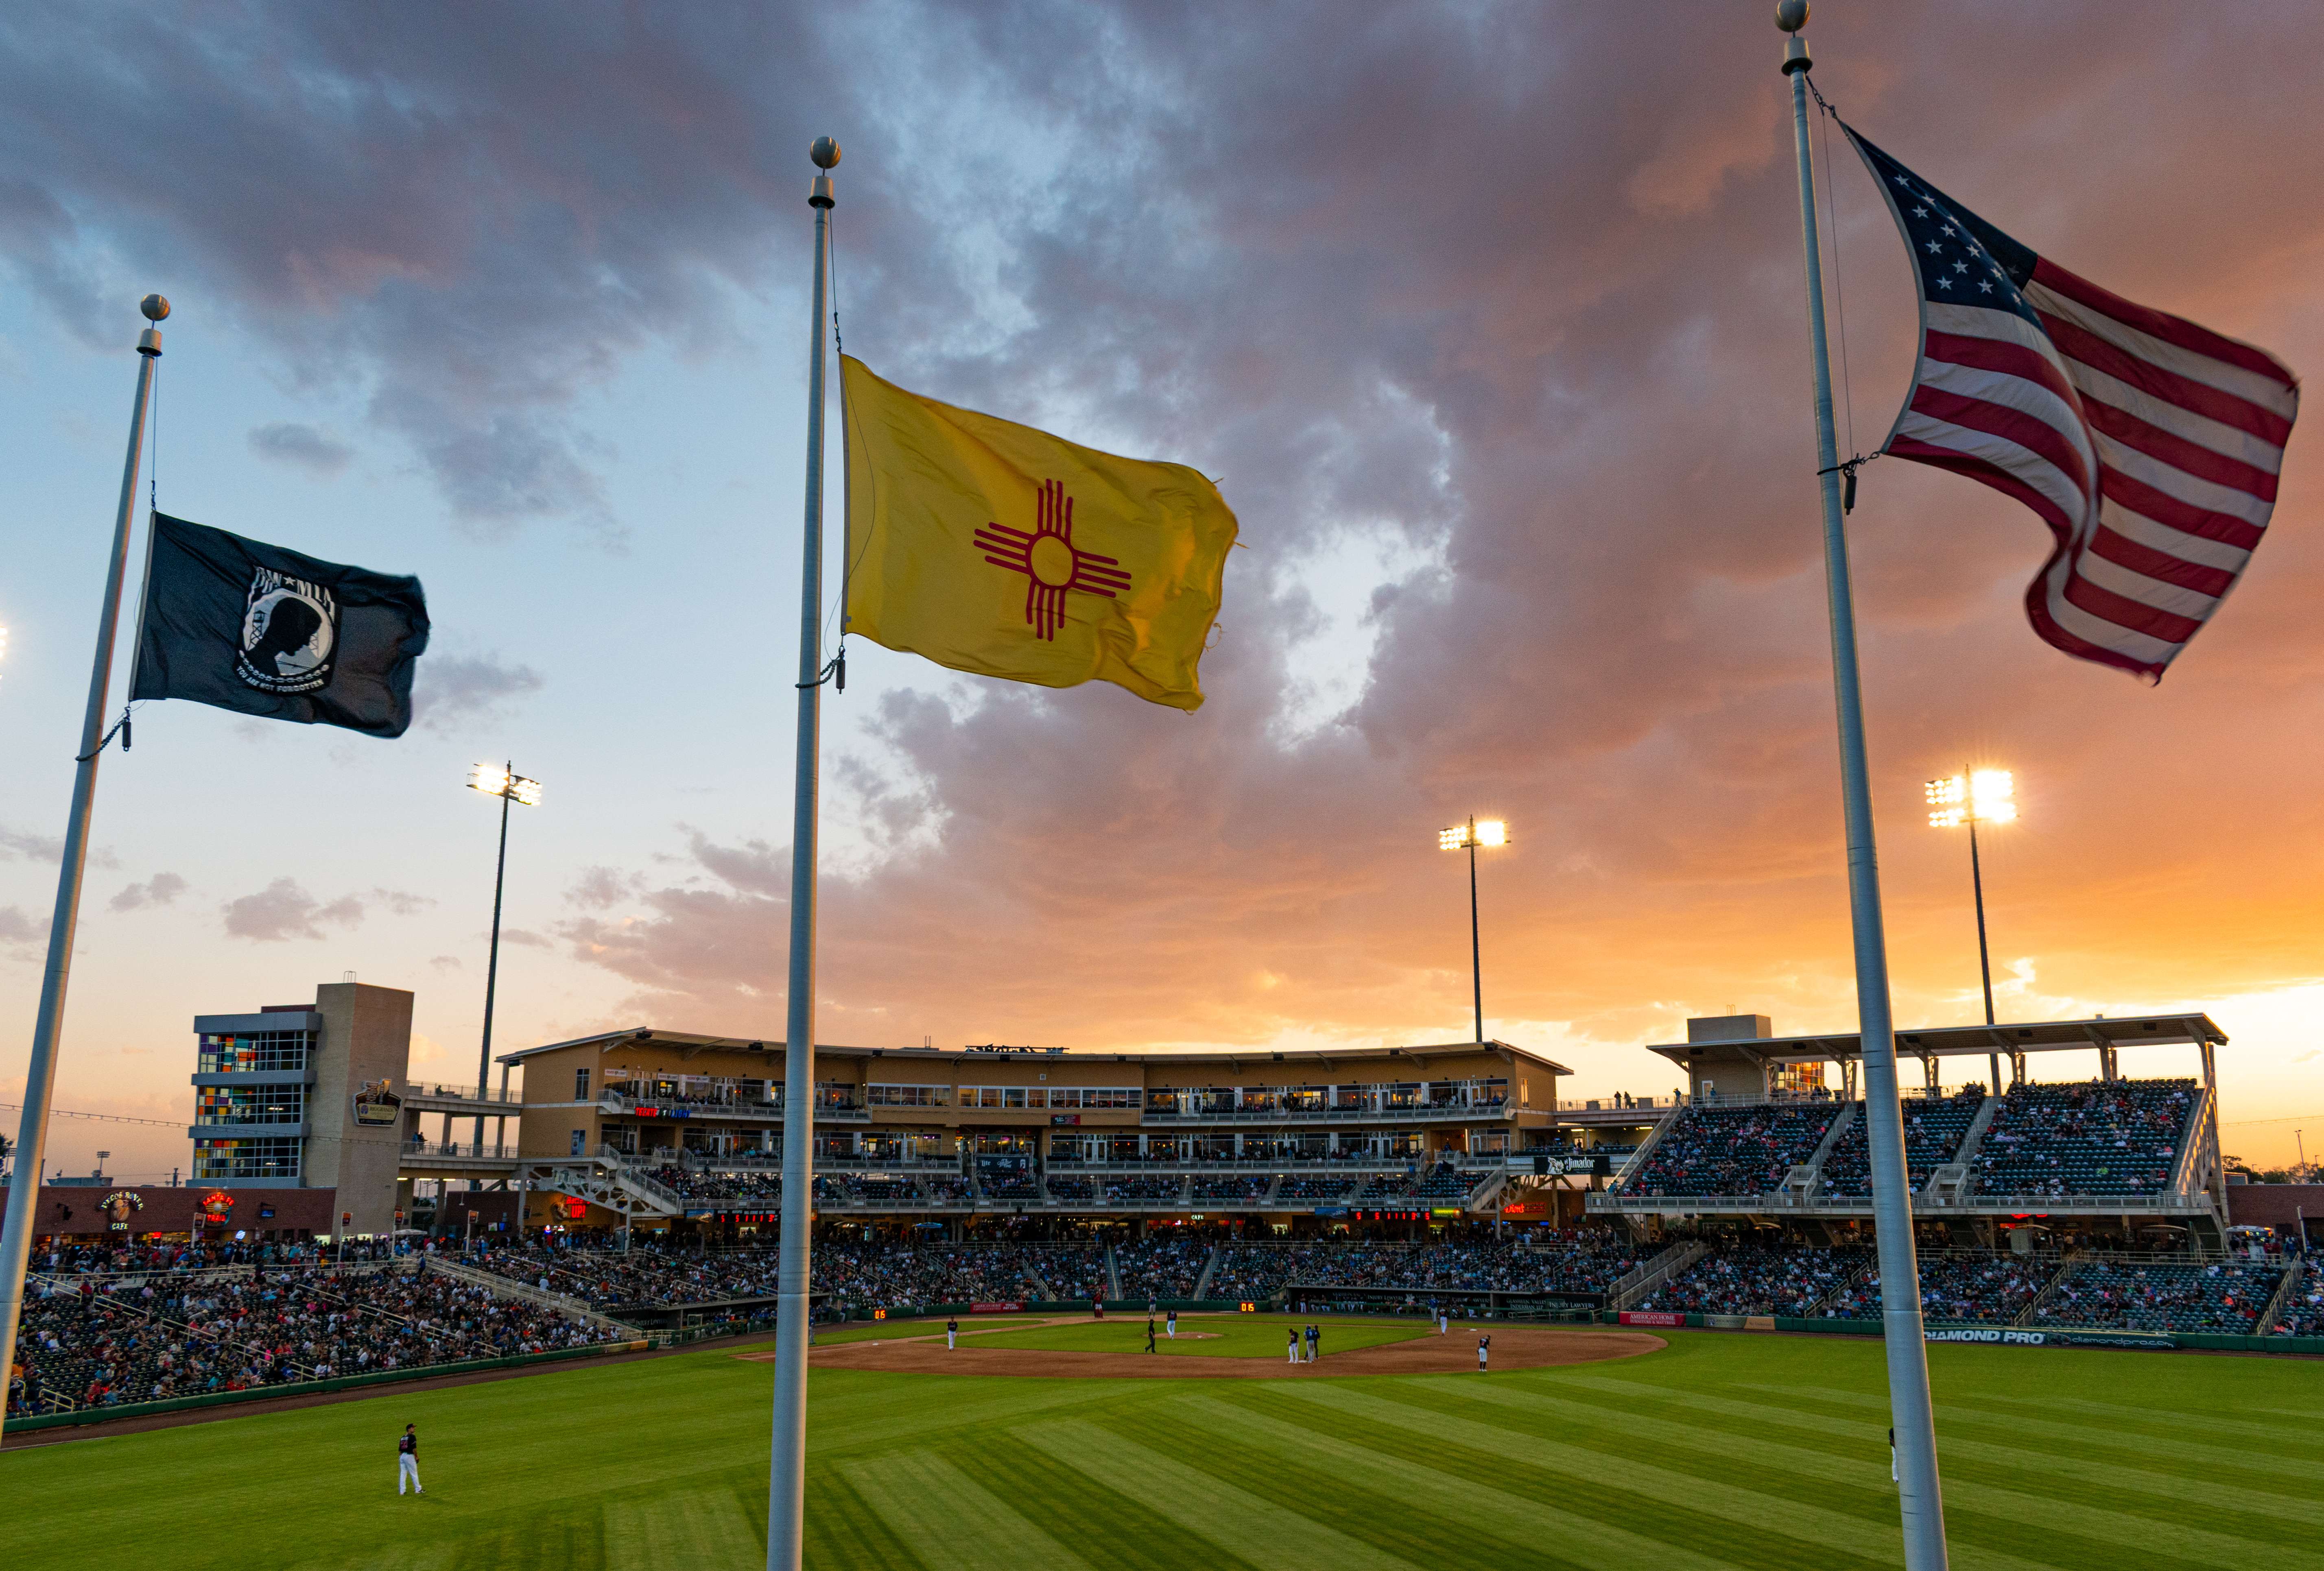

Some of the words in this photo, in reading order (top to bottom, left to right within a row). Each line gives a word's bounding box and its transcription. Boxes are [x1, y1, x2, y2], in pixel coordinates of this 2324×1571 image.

[247, 566, 282, 612] POW
[296, 578, 335, 623] MIA
[236, 666, 248, 678] YOU
[246, 676, 260, 686] ARE
[276, 679, 324, 692] FORGOTTEN
[635, 1107, 658, 1118] TECATE
[670, 1110, 691, 1118] LIGHT
[1566, 1156, 1595, 1171] Jimador
[100, 1191, 123, 1209] PECOS
[124, 1192, 144, 1211] RIVER
[203, 1194, 225, 1206] SANTA
[226, 1196, 235, 1206] FE
[571, 1204, 586, 1218] UP!
[721, 1214, 725, 1222] 5
[735, 1214, 740, 1222] 5
[1924, 1330, 2001, 1341] DIAMOND
[2003, 1331, 2044, 1344] PRO
[2071, 1336, 2174, 1348] diamondpro.com
